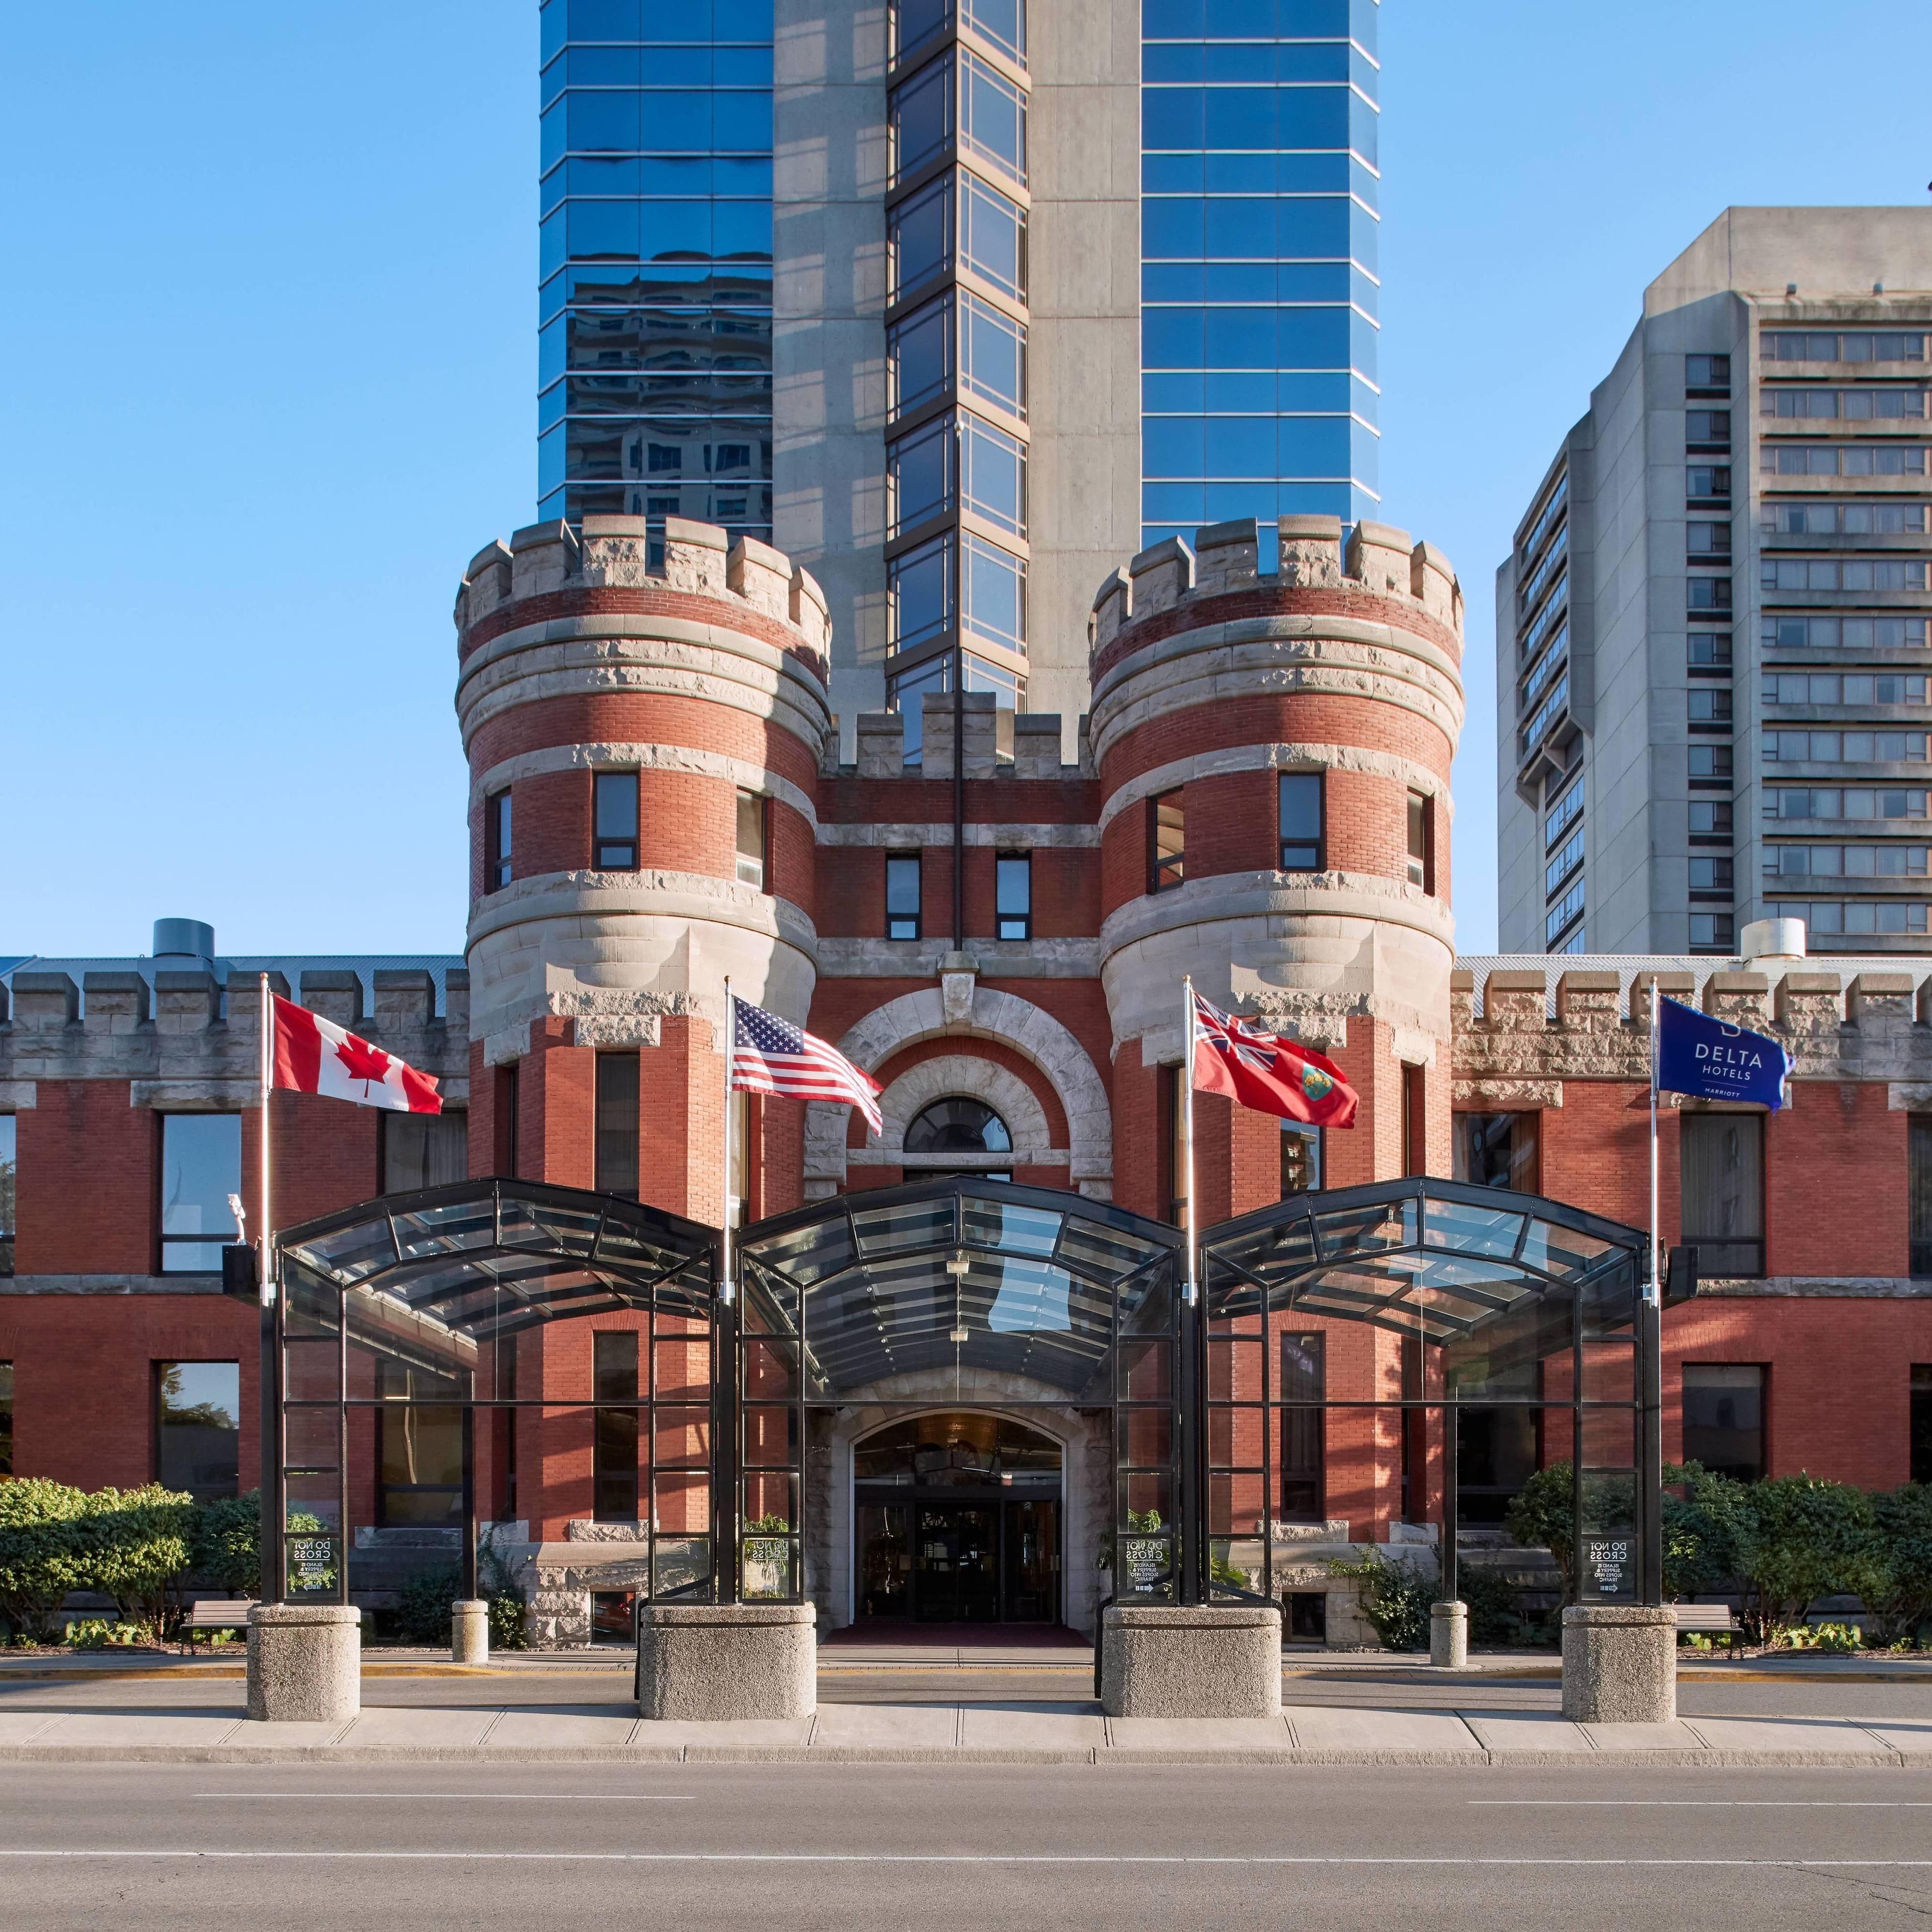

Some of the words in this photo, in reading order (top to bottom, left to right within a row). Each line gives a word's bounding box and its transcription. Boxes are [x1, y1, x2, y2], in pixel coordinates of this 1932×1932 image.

[1695, 1043, 1762, 1068] DELTA
[1703, 1065, 1751, 1081] HOTELS
[1705, 1088, 1740, 1098] MARRIOTT
